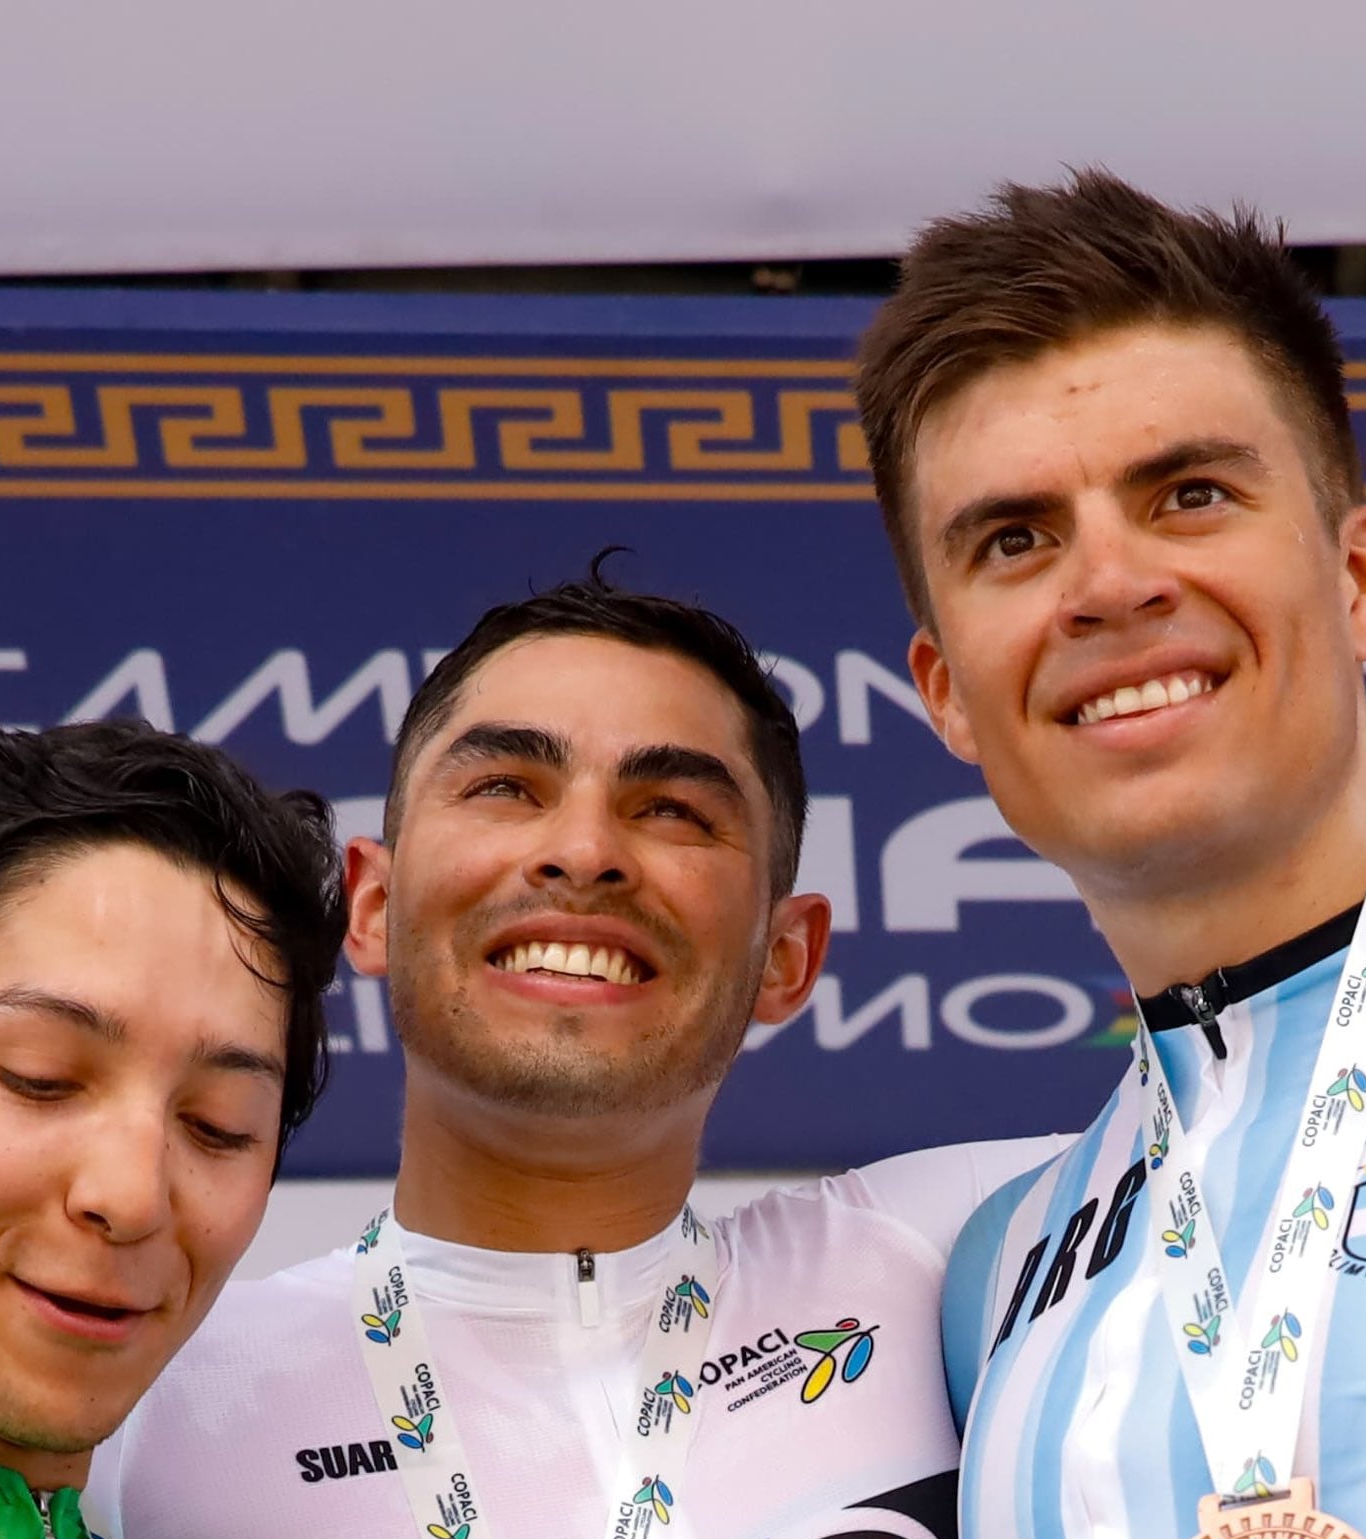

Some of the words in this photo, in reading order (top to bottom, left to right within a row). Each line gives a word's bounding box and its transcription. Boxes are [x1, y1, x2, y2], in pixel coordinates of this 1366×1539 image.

[1336, 975, 1363, 1027] COPACI
[1302, 1095, 1327, 1147] COPACI
[1269, 1219, 1293, 1273] COPACI
[388, 1266, 410, 1307] COPACI
[698, 1328, 790, 1391] OPACI
[725, 1377, 746, 1391] PAN
[747, 1348, 798, 1380] AMERICAN
[760, 1356, 802, 1384] CYCLING
[1239, 1350, 1262, 1410] COPACI
[415, 1363, 441, 1411] COPACI
[727, 1364, 808, 1412] CONFEDERATION
[637, 1388, 656, 1437] COPACI
[451, 1473, 478, 1522] COPACI
